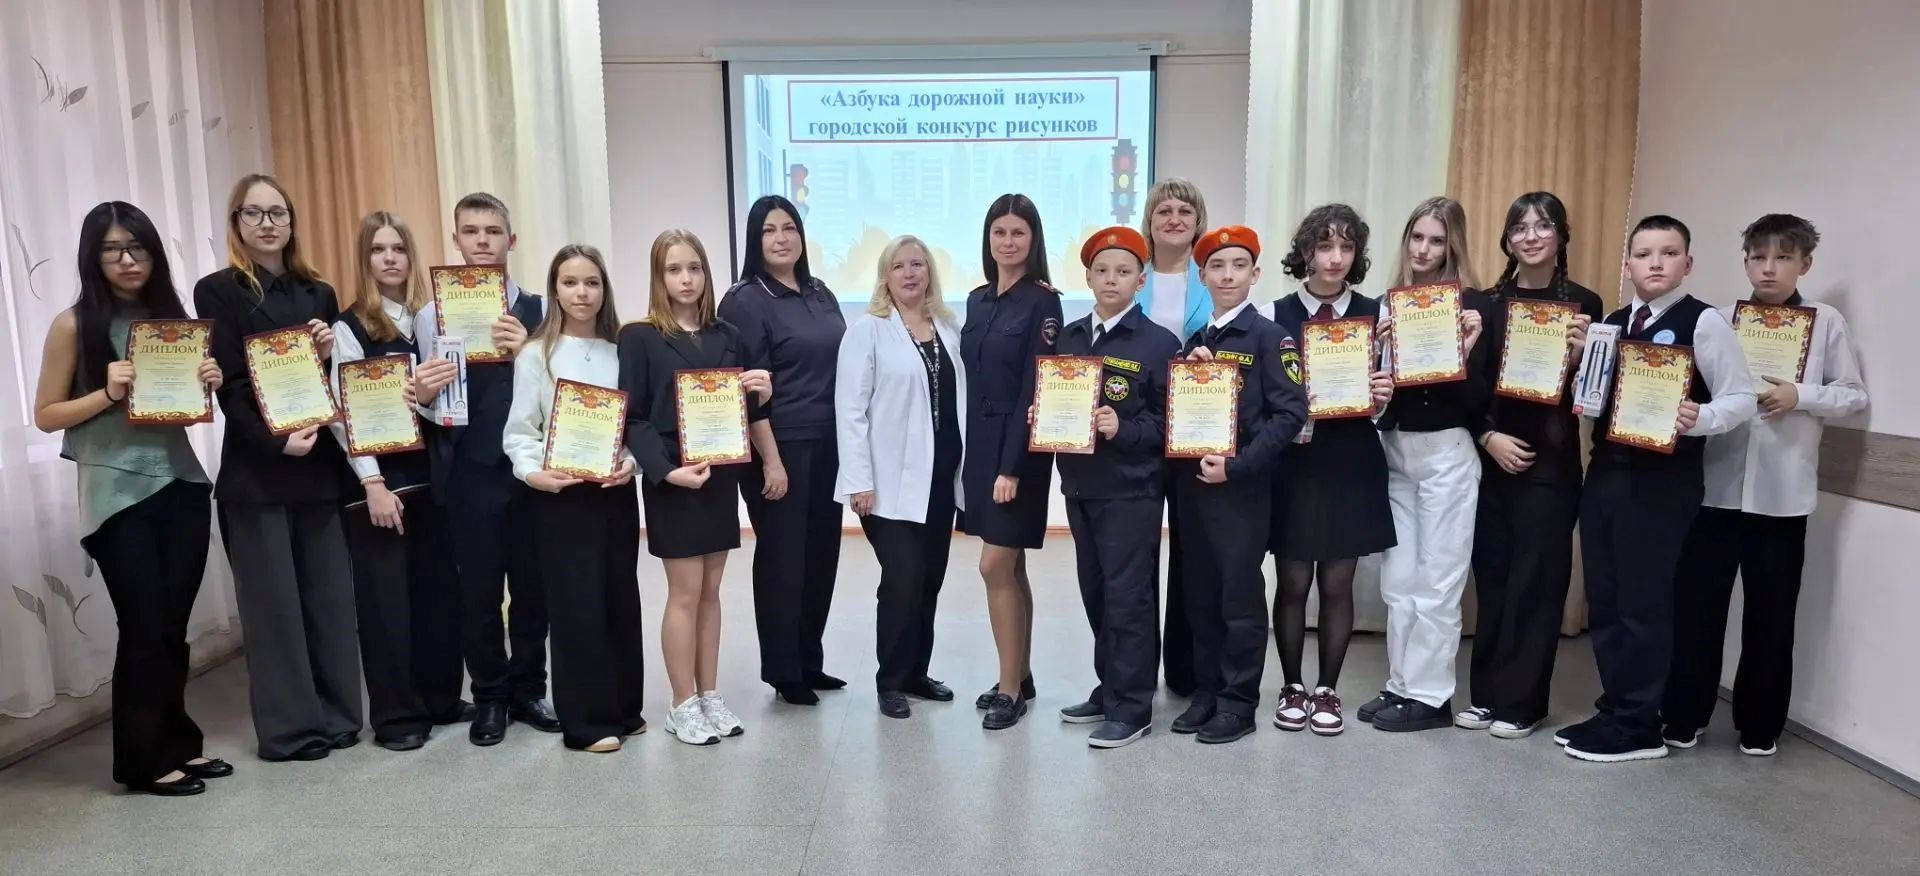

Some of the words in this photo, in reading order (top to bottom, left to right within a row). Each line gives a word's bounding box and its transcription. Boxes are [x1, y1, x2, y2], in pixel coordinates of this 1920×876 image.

[820, 89, 901, 114] «Азбука
[908, 88, 1005, 112] дорожной
[1015, 91, 1085, 110] науки»
[808, 118, 908, 139] городской
[916, 120, 997, 139] конкурс
[1005, 119, 1099, 138] рисунков
[446, 290, 496, 300] ДИПЛОМ
[1400, 308, 1450, 323] ДИПЛОМ
[1514, 324, 1564, 338] ДИПЛОМ
[1742, 328, 1798, 342] ДИПЛОМ
[139, 344, 198, 354] ДИПЛОМ
[1313, 344, 1363, 356] ДИПЛОМ
[261, 353, 310, 370] ДИПЛОМ
[1629, 366, 1680, 383] ДИПЛОМ
[352, 380, 402, 394] ДИПЛОМ
[1046, 381, 1090, 391] ДИПЛОМ
[1178, 386, 1227, 395] ДИПЛОМ
[688, 394, 735, 404] ДИПЛОМ
[564, 406, 613, 423] ДИПЛОМ
